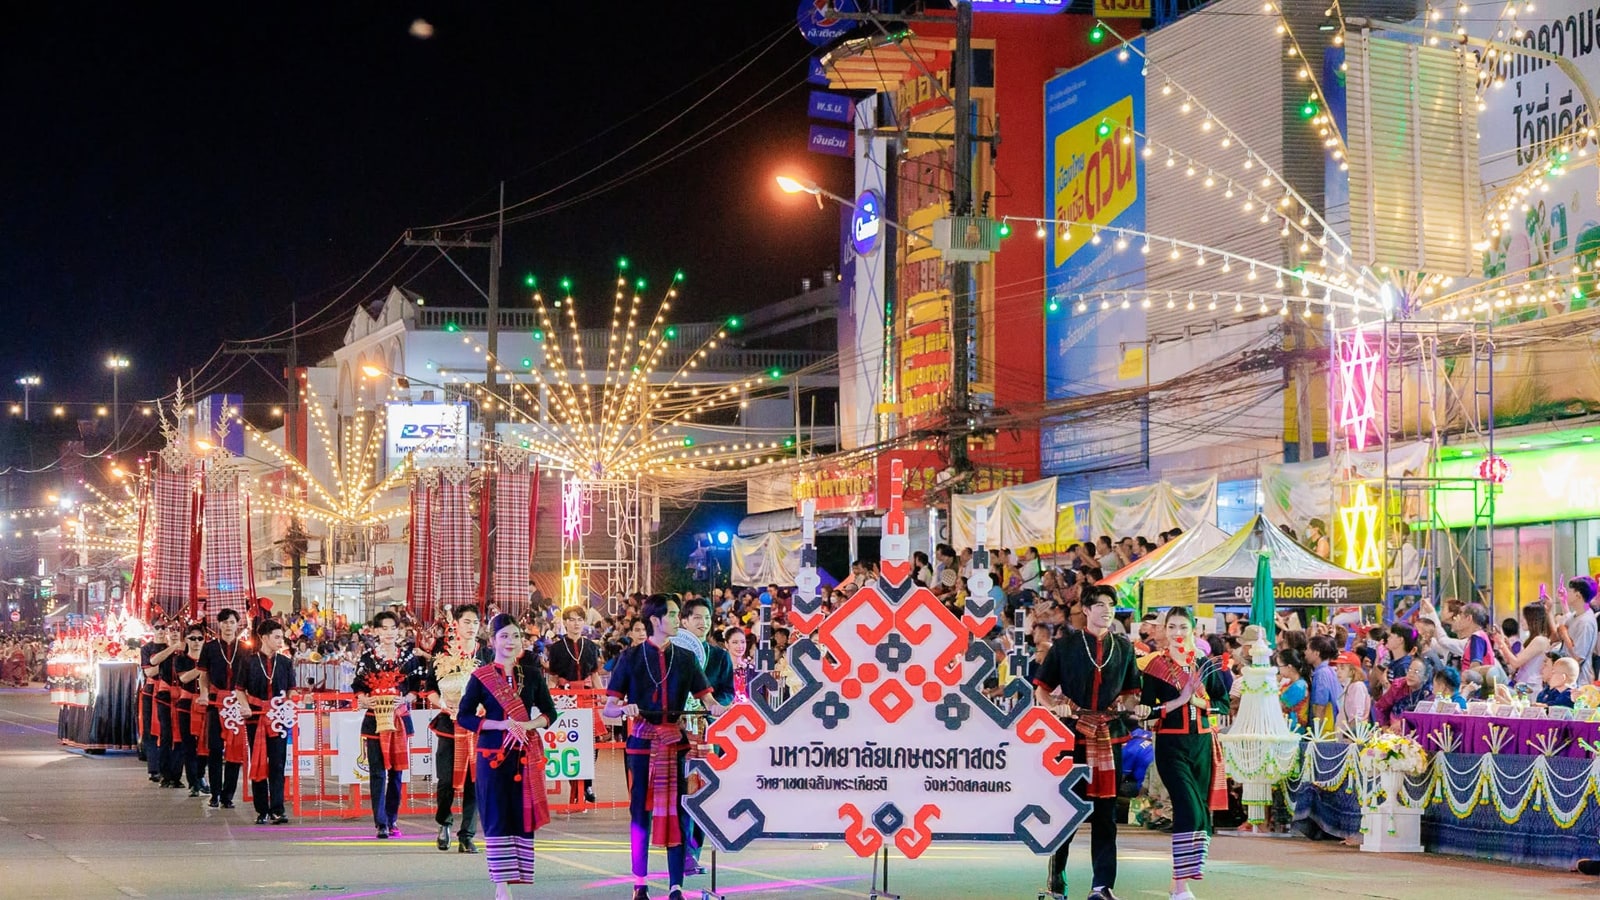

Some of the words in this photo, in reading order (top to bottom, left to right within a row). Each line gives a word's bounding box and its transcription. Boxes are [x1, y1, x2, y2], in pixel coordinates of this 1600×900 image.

[812, 134, 846, 148] เงินด่วน
[558, 718, 579, 728] AIS
[544, 746, 581, 778] 5G
[769, 741, 1009, 770] มหาวิทยาลัยเกษตรศาสตร์
[756, 774, 888, 791] วิทยาเขตเฉลิมพระเกียรติ
[924, 775, 1012, 792] จังหวัดสกลนคร
